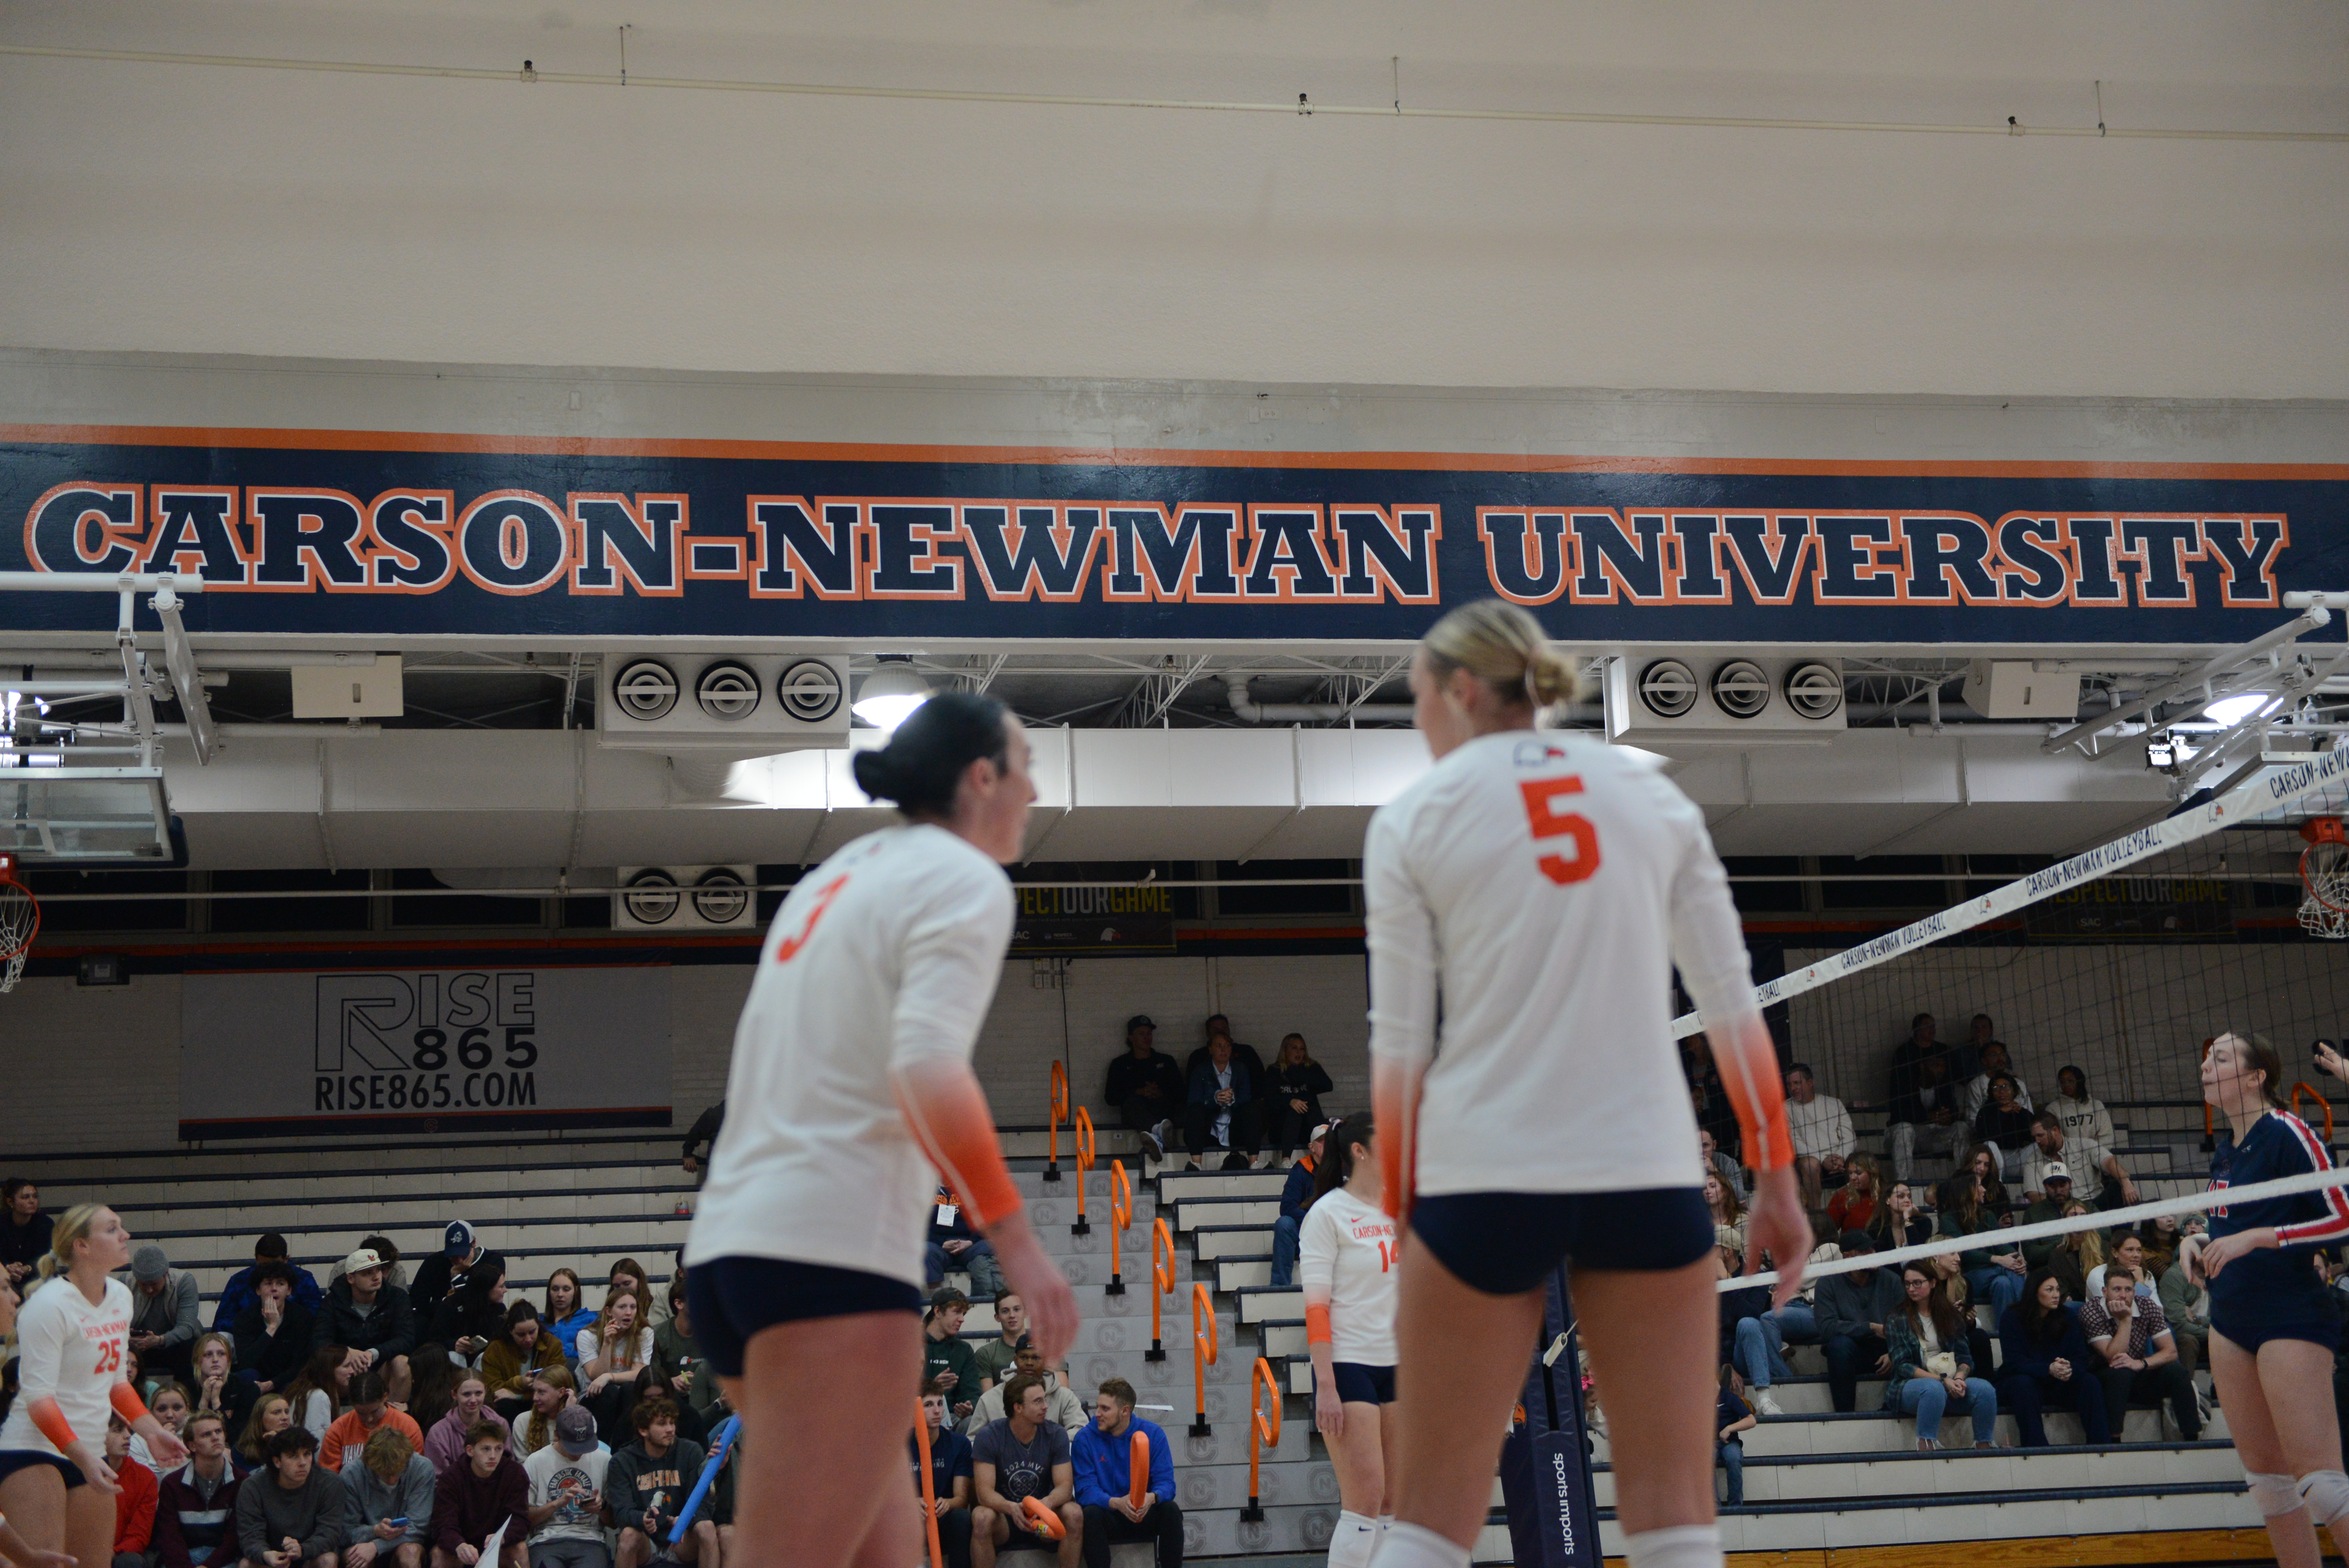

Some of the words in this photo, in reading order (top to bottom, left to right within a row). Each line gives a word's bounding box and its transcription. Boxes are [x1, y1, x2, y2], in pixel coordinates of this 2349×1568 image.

[23, 480, 1442, 605] CARSON-NEWMAN
[1475, 505, 2290, 608] UNIVERSITY
[1517, 772, 1602, 887] 5
[2025, 849, 2103, 897] CARSON-NEWMAN
[2104, 823, 2163, 865] VOLLEYBALL
[315, 972, 535, 1072] RISE
[412, 1027, 538, 1071] 865
[315, 1071, 537, 1111] RISE865.COM
[2065, 1114, 2093, 1128] 1977
[94, 1338, 121, 1375] 25
[1004, 1460, 1025, 1476] 2024
[1552, 1452, 1568, 1498] sports
[1559, 1499, 1575, 1555] imports
